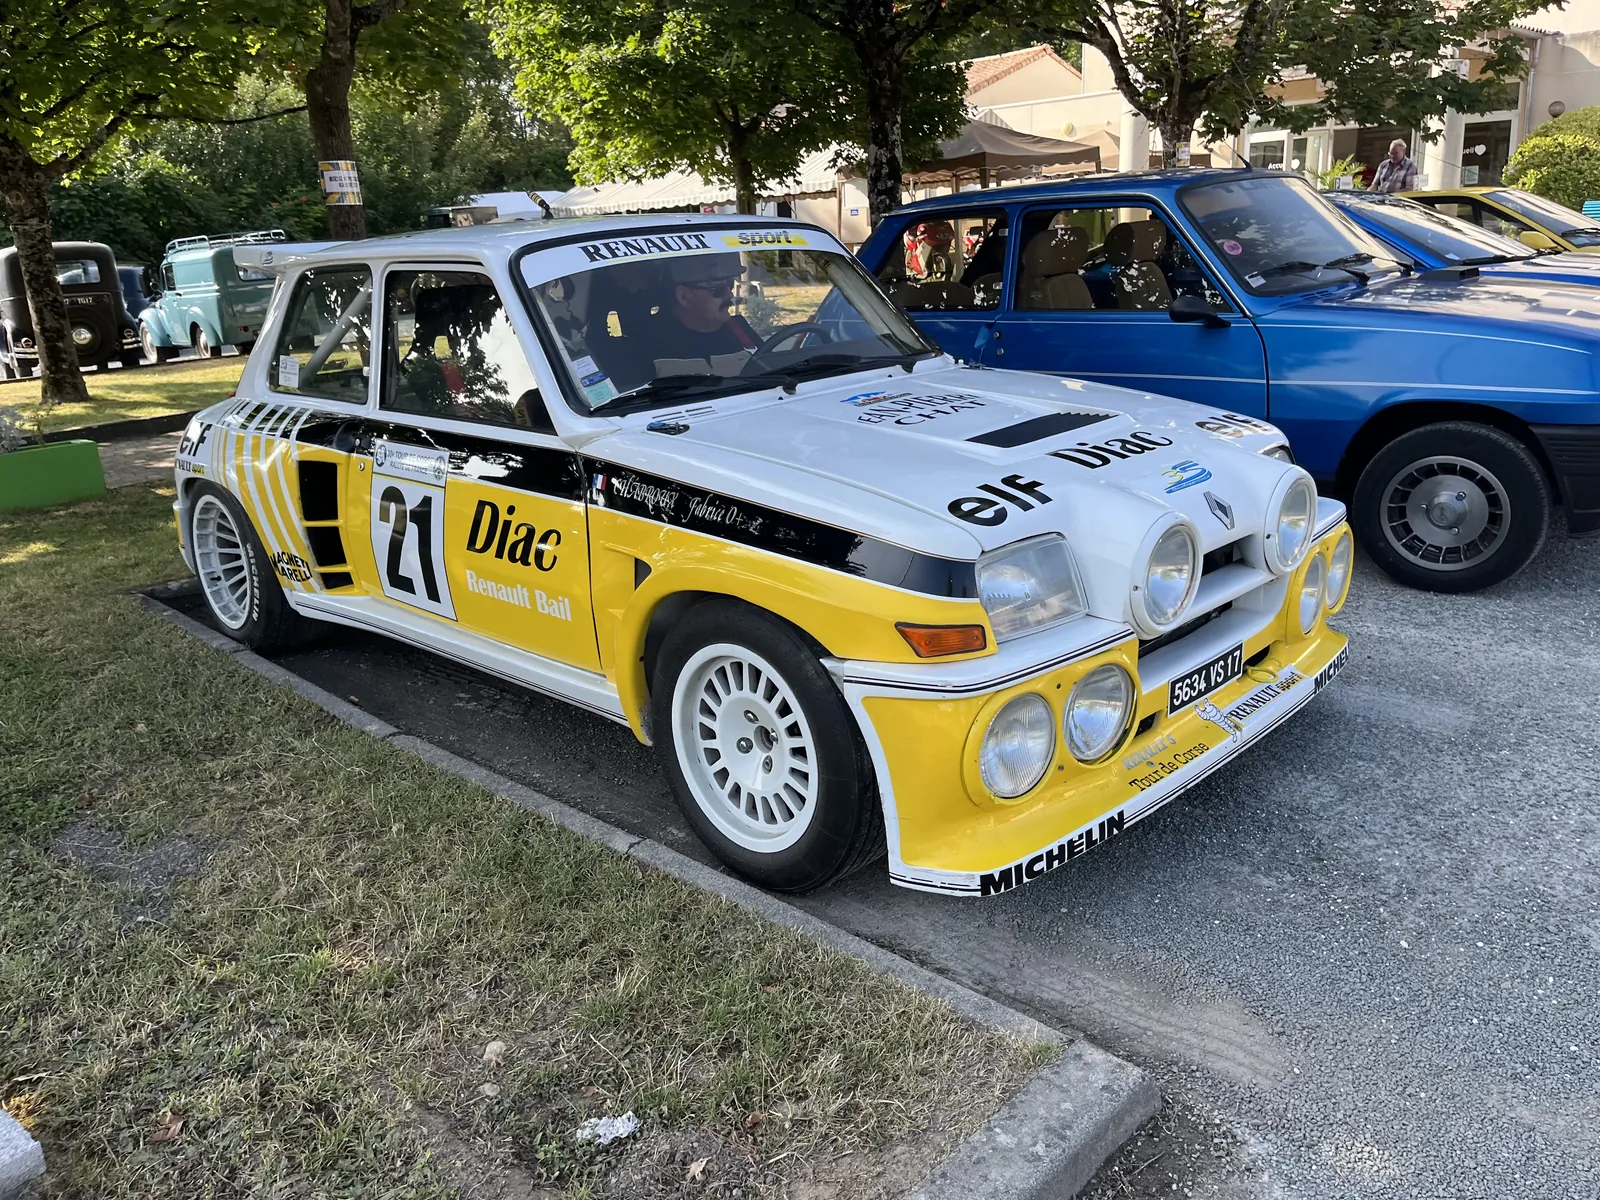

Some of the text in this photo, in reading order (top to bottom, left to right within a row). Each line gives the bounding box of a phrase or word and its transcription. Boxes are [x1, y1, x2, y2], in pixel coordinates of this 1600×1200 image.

[577, 230, 792, 263] RENAULT sport
[894, 400, 986, 425] CHAT
[1195, 413, 1273, 438] elf
[395, 451, 409, 460] TOUR
[1045, 431, 1173, 469] Diac
[682, 494, 725, 523] Fabrice
[948, 474, 1053, 527] elf
[379, 486, 441, 604] 21
[466, 499, 562, 572] Diac
[465, 569, 572, 622] Renault Bail
[1173, 650, 1241, 706] 5634 VS 17
[1230, 671, 1303, 721] RENAULT sport
[1121, 733, 1177, 770] RENAULT 5
[1129, 742, 1210, 792] Tour de Corse
[980, 809, 1125, 897] MICHELIN
